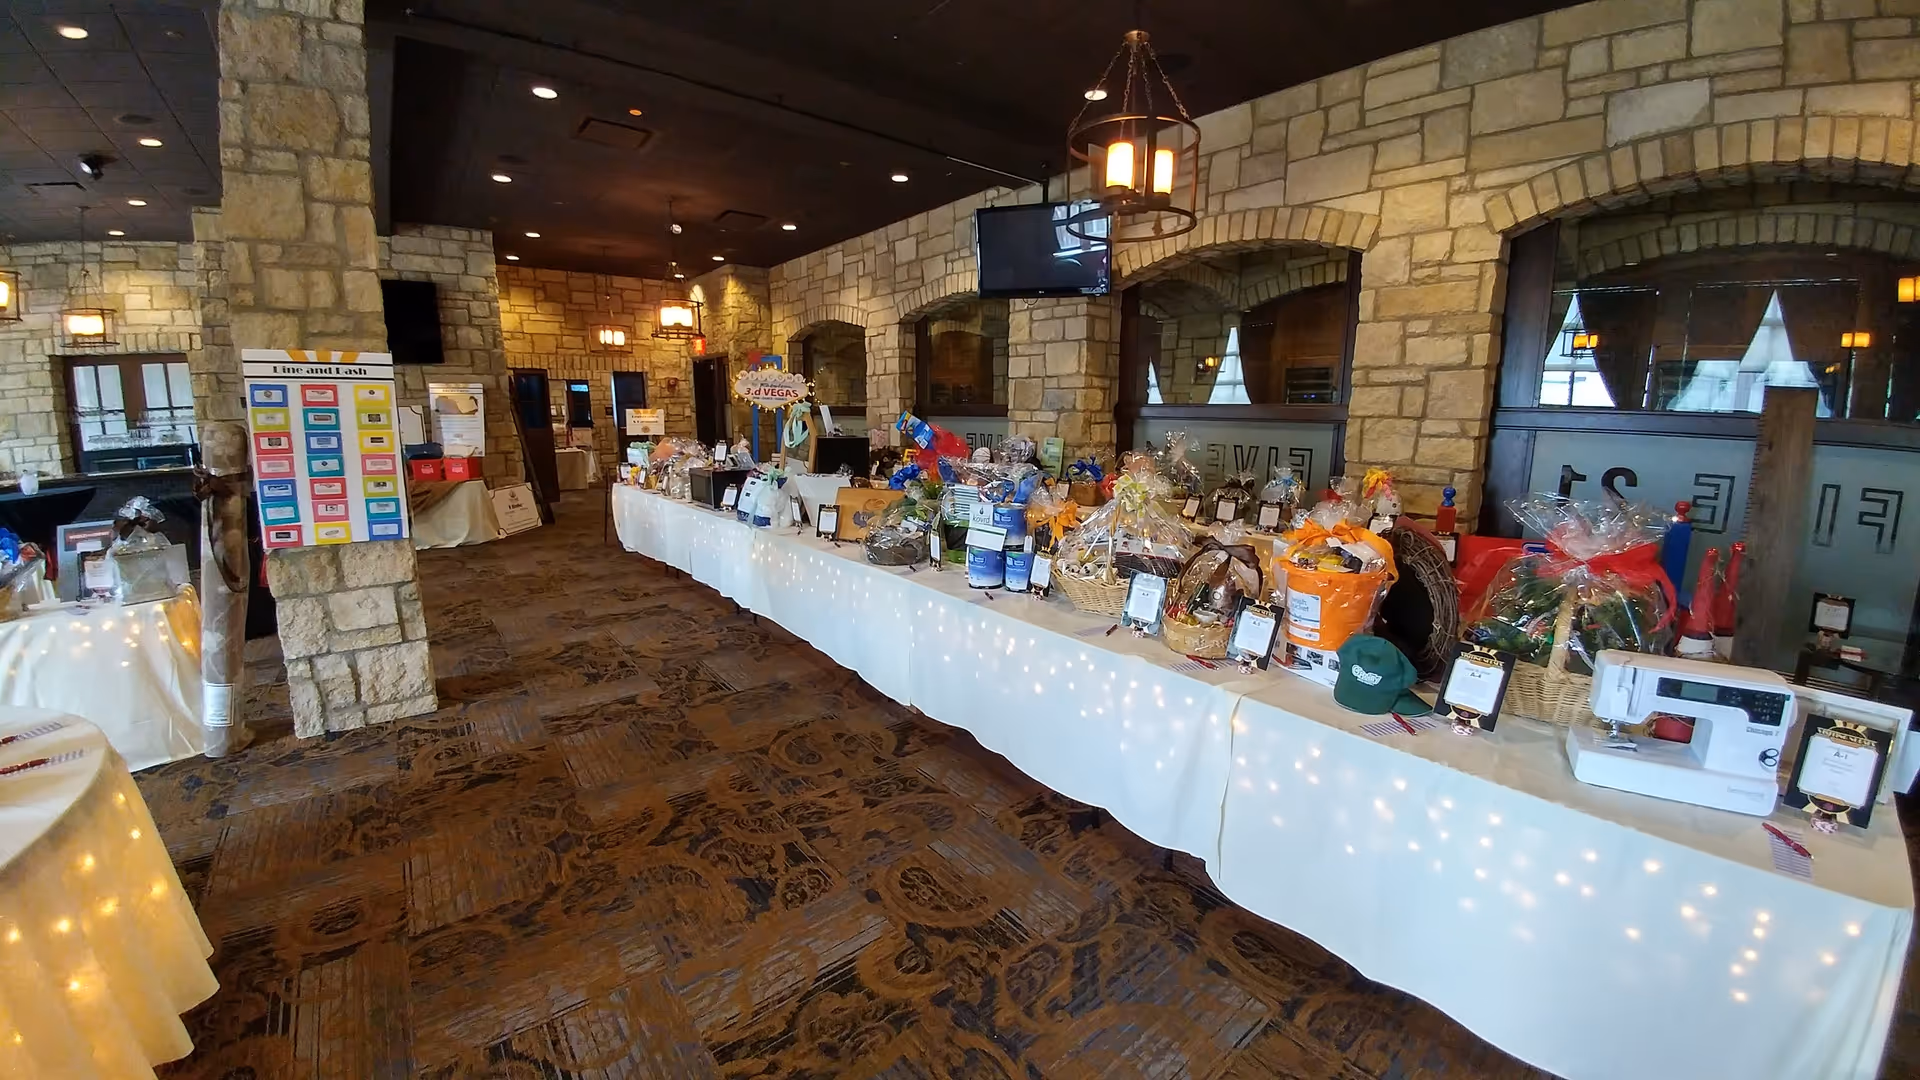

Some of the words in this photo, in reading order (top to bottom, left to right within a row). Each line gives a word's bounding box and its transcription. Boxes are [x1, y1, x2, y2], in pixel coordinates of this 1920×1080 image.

[306, 367, 332, 375] and
[335, 367, 367, 376] Dash
[740, 372, 801, 380] WELCOME
[763, 388, 798, 397] VEGAS
